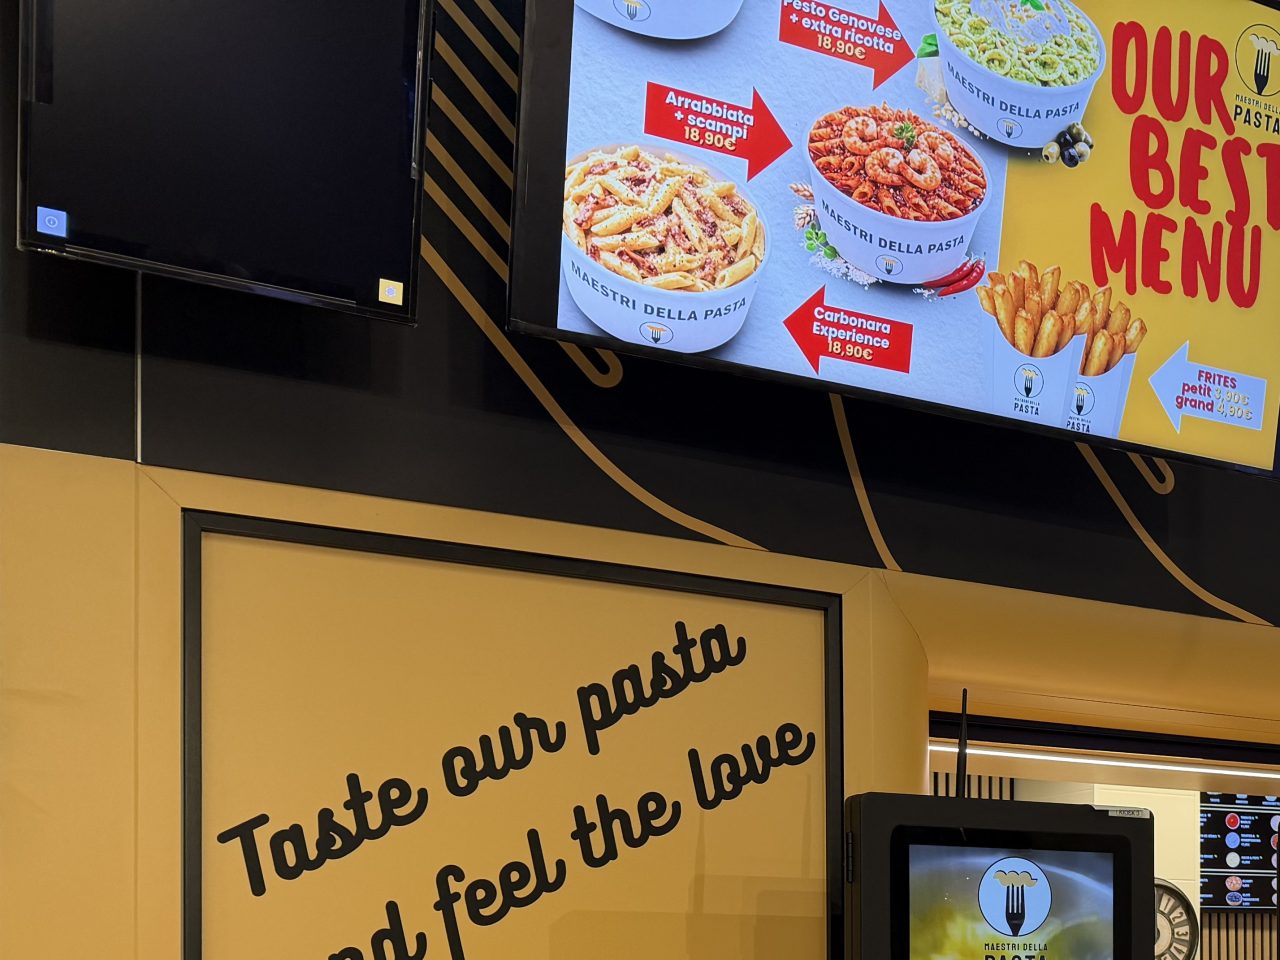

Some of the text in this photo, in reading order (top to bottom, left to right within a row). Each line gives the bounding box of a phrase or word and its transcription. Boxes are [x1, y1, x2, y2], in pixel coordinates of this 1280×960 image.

[802, 17, 842, 38] extra
[844, 29, 894, 54] ricotta
[828, 8, 901, 41] Genovese
[816, 34, 866, 59] 18,90€
[947, 61, 1080, 119] MAESTRI DELLA PASTA
[1111, 20, 1236, 136] OUR
[665, 91, 755, 126] Arrabbiata
[1235, 94, 1263, 110] MAESTRI
[687, 114, 748, 139] scampi
[1233, 104, 1280, 135] PASTA
[684, 126, 736, 151] 18,90€
[821, 199, 965, 255] MAESTRI DELLA PASTA
[1089, 202, 1262, 309] MENU
[571, 260, 747, 321] MAESTRI DELLA PASTA
[814, 306, 891, 335] Carbonara
[812, 321, 890, 350] Experience
[827, 340, 874, 361] 18,90€
[1197, 369, 1237, 389] FRITES
[1175, 394, 1253, 421] grand 4,90€
[1182, 382, 1250, 406] petit 3,90€
[1014, 402, 1040, 416] PASTA
[217, 620, 748, 898] Taste our pasta
[571, 794, 682, 869] the
[687, 722, 817, 810] love
[984, 943, 1048, 952] MAESTRI DELLA
